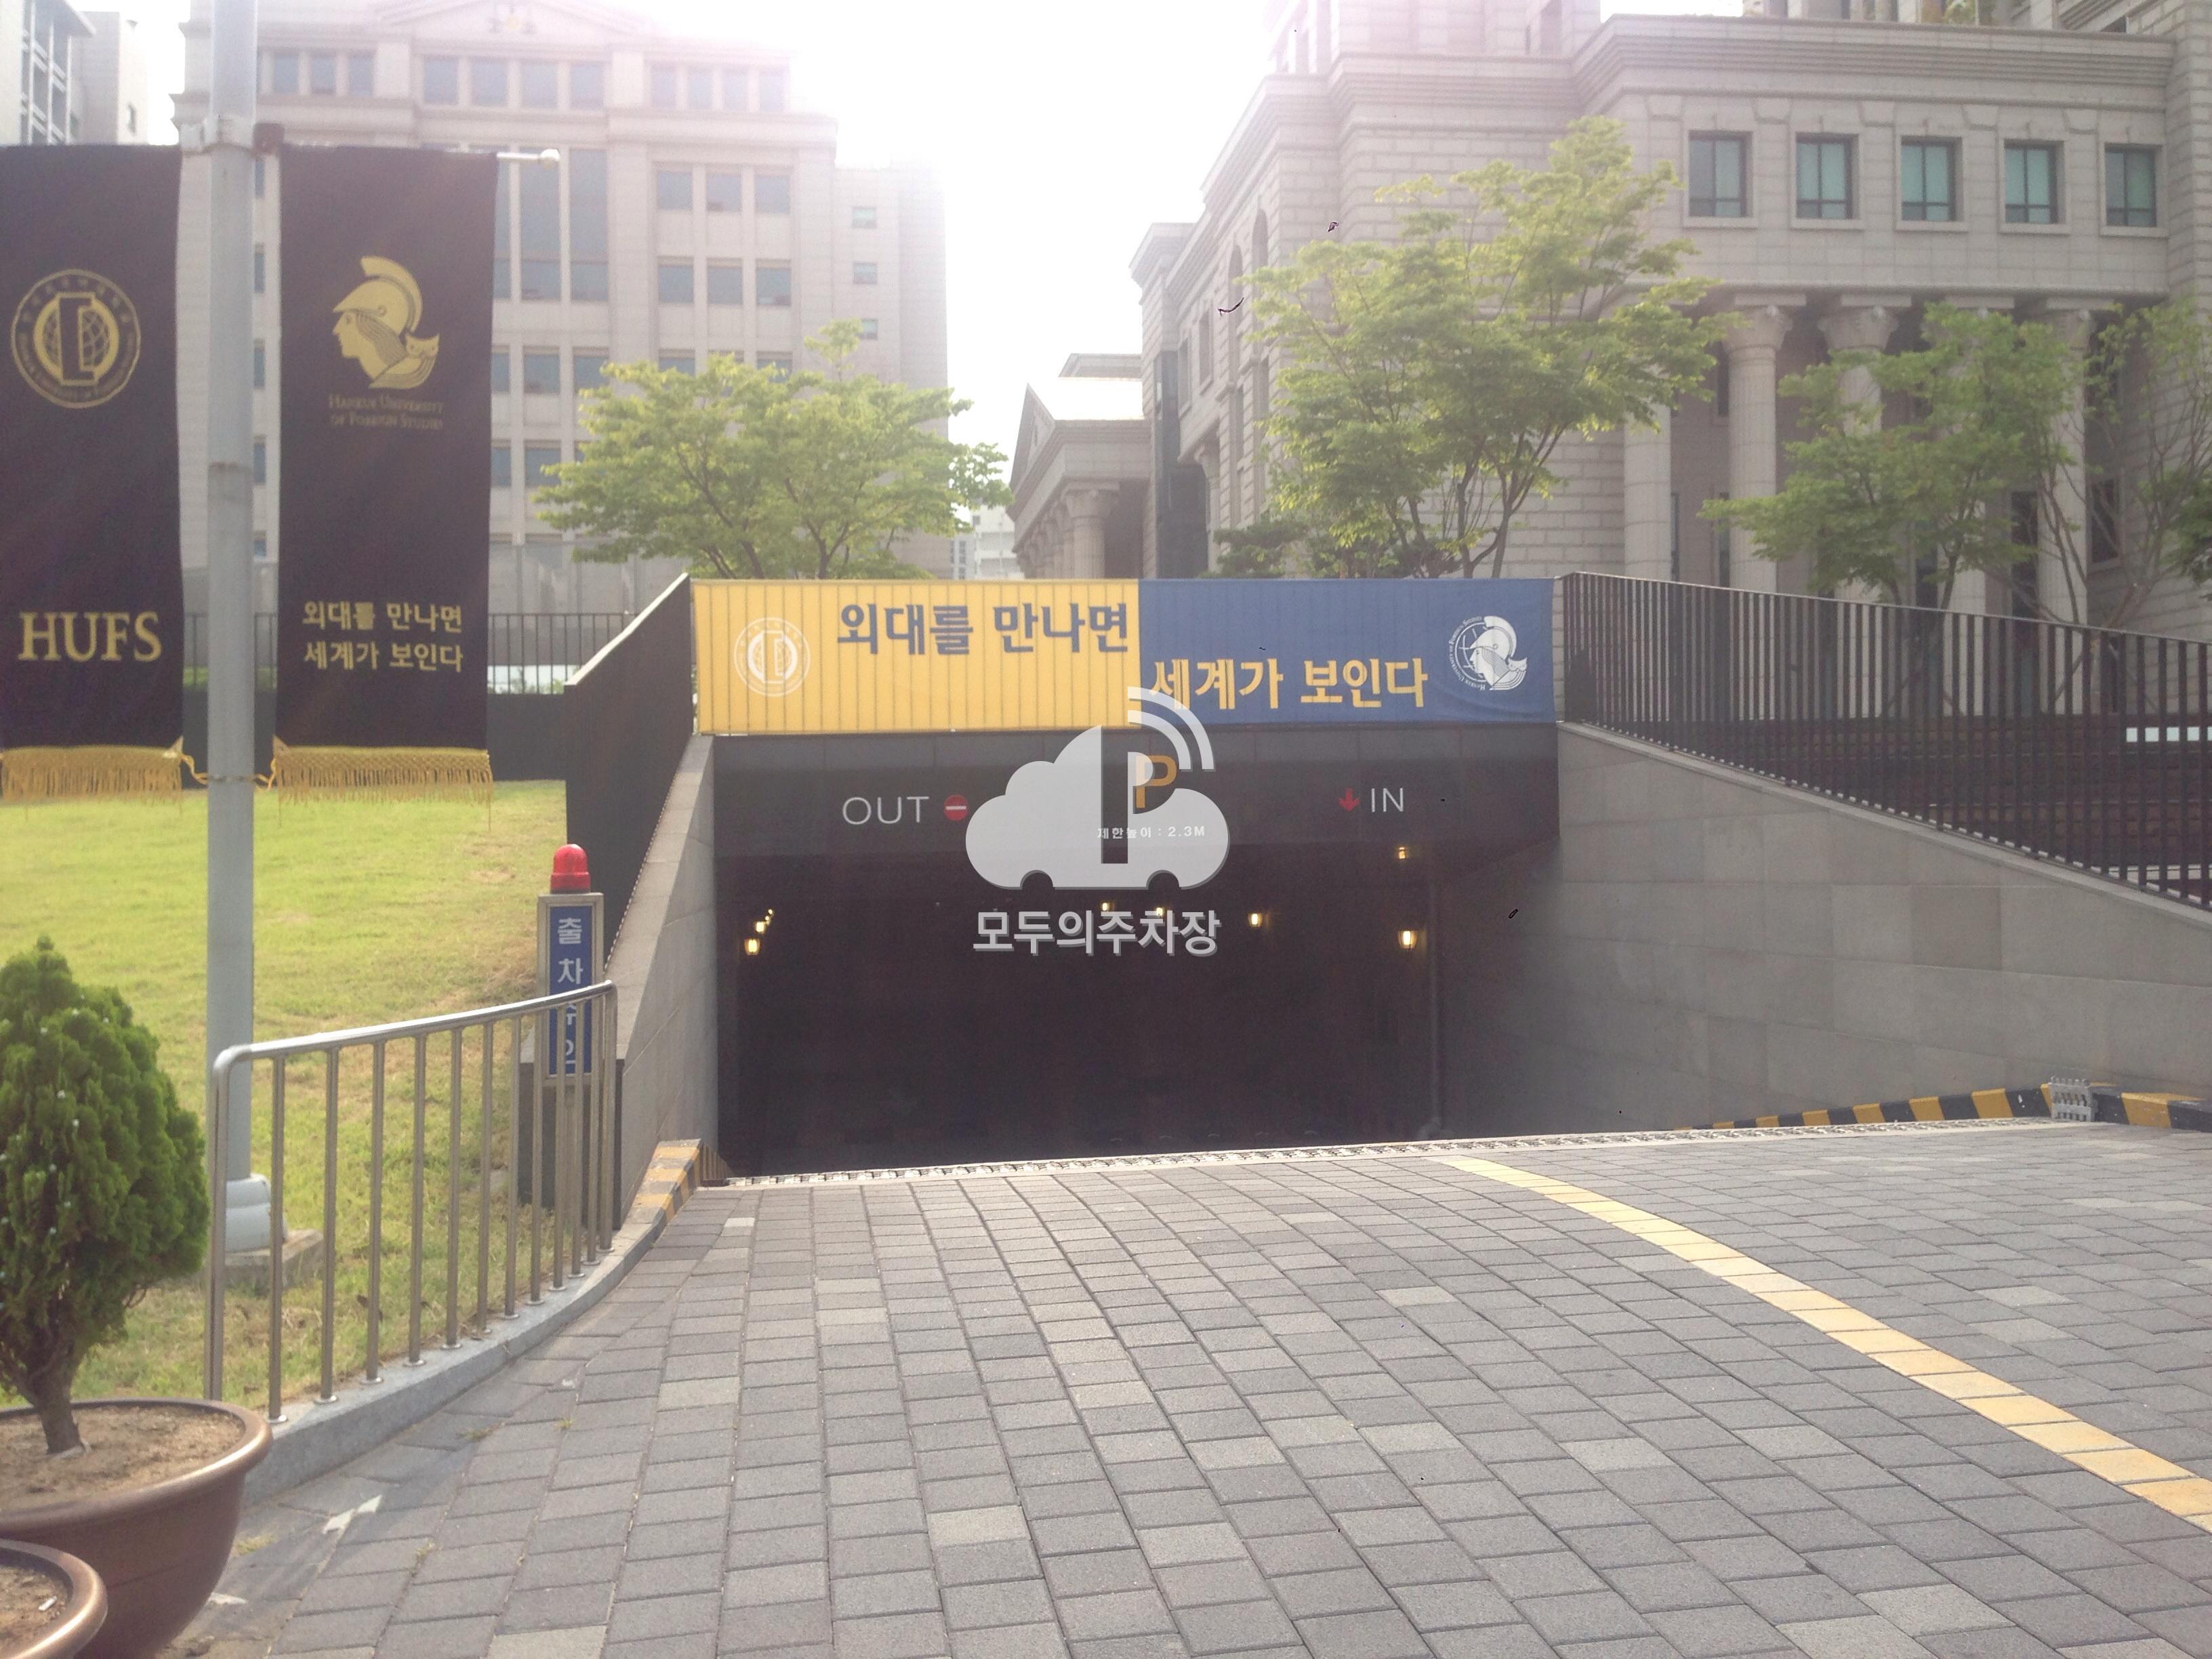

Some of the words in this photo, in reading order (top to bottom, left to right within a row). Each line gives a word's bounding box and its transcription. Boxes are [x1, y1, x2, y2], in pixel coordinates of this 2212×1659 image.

[302, 601, 375, 631] 외대를
[386, 602, 463, 633] 만나면
[838, 602, 973, 655] 외대를
[993, 602, 1128, 653] 만나면
[18, 612, 163, 662] HUFS
[303, 640, 380, 671] 세계가
[388, 641, 464, 672] 보인다
[1149, 658, 1284, 710] 세계가
[1300, 657, 1428, 708] 보인다
[842, 796, 929, 825] OUT
[1370, 787, 1404, 814] IN
[1097, 826, 1151, 840] 제한높이
[1168, 825, 1206, 838] 2.3M
